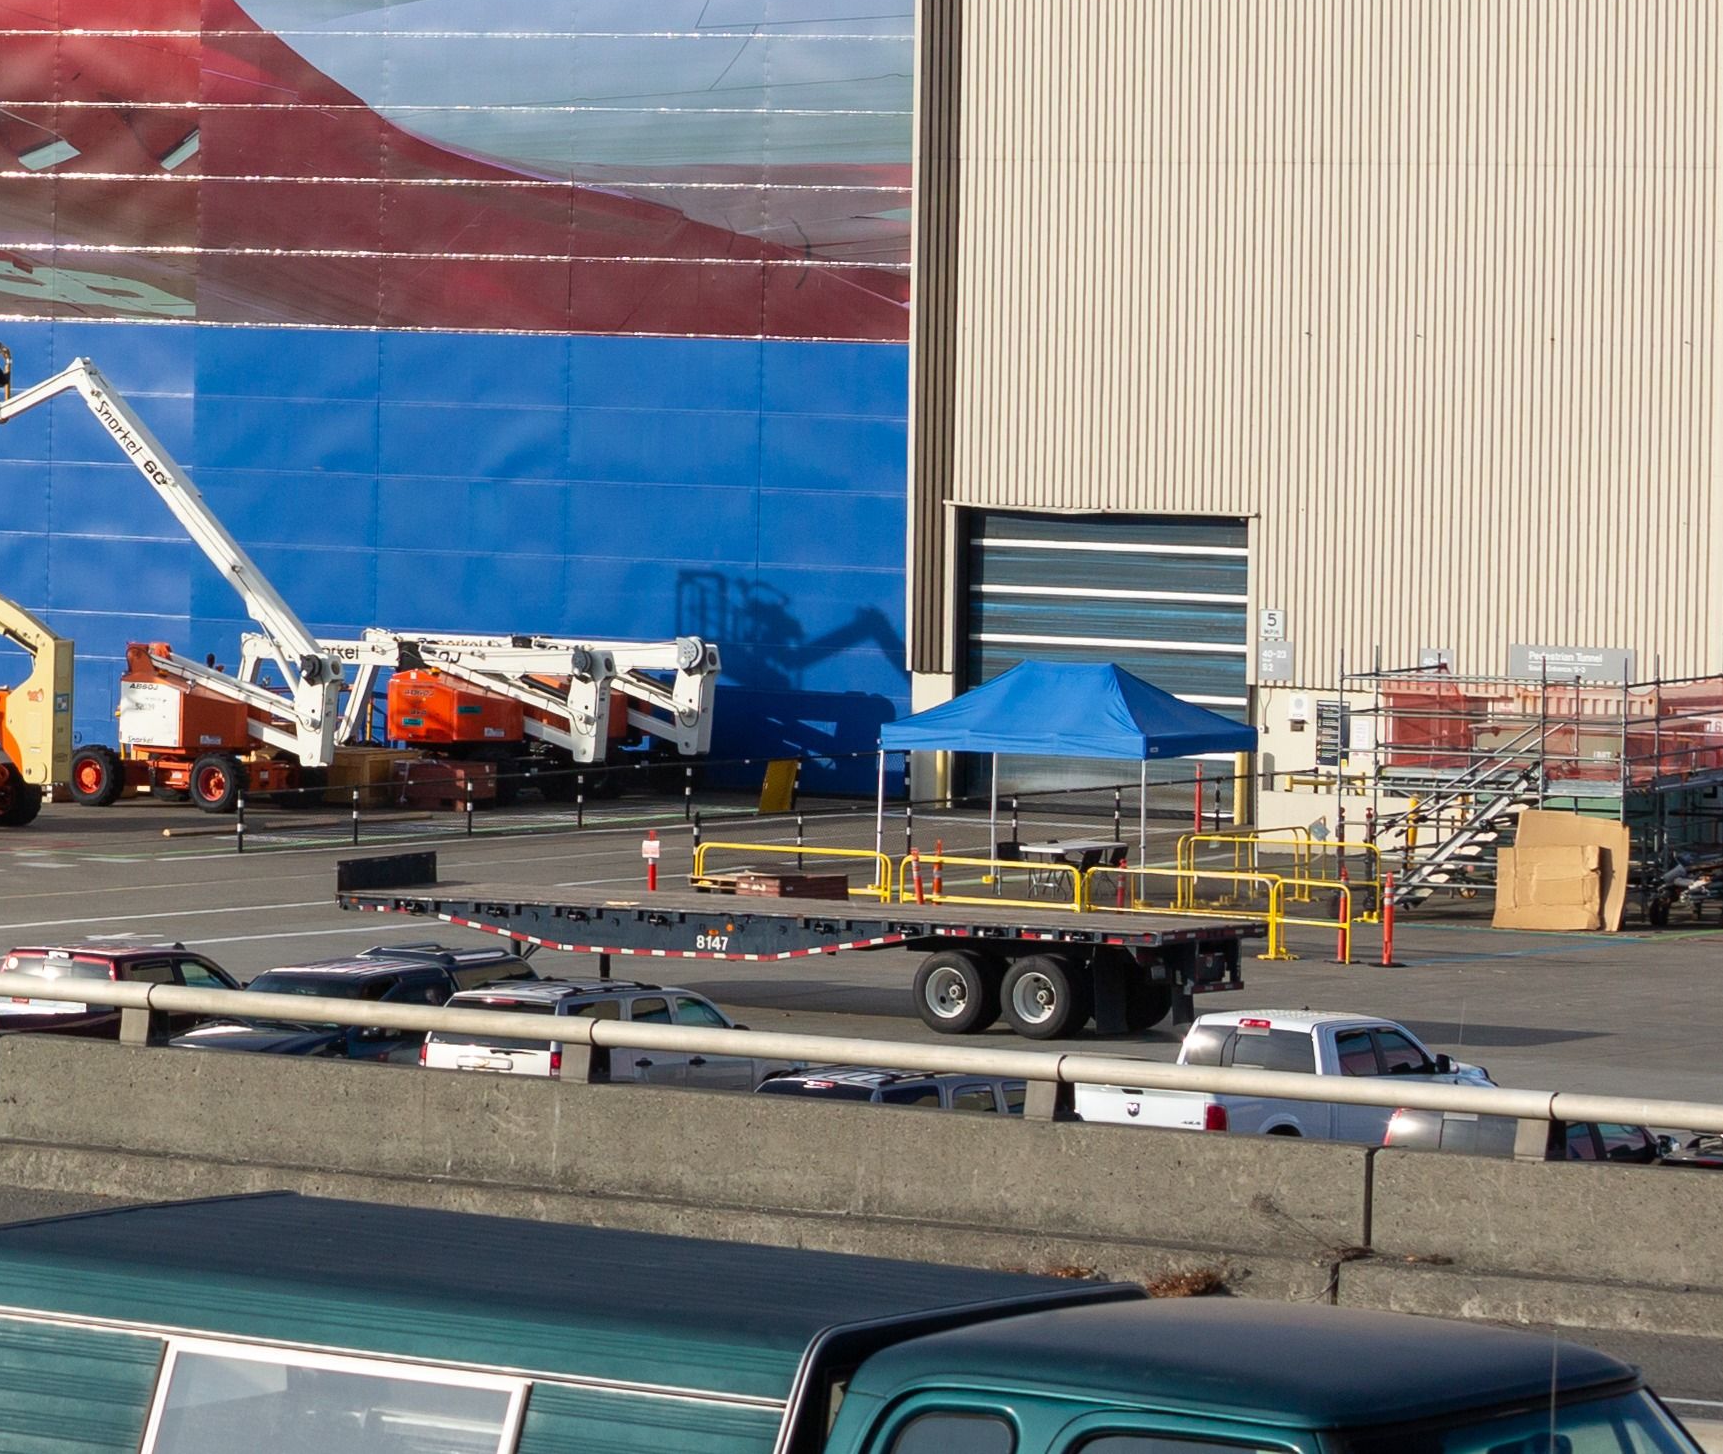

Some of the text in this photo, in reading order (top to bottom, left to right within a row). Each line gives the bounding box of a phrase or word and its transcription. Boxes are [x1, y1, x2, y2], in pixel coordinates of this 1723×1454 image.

[95, 400, 143, 456] Snorkel
[1267, 613, 1277, 627] 5
[1263, 628, 1280, 636] MPH
[1262, 650, 1287, 659] 40-23
[1528, 650, 1603, 663] Pedestrian Tunnel
[1262, 663, 1274, 672] S2
[696, 934, 729, 951] 8147
